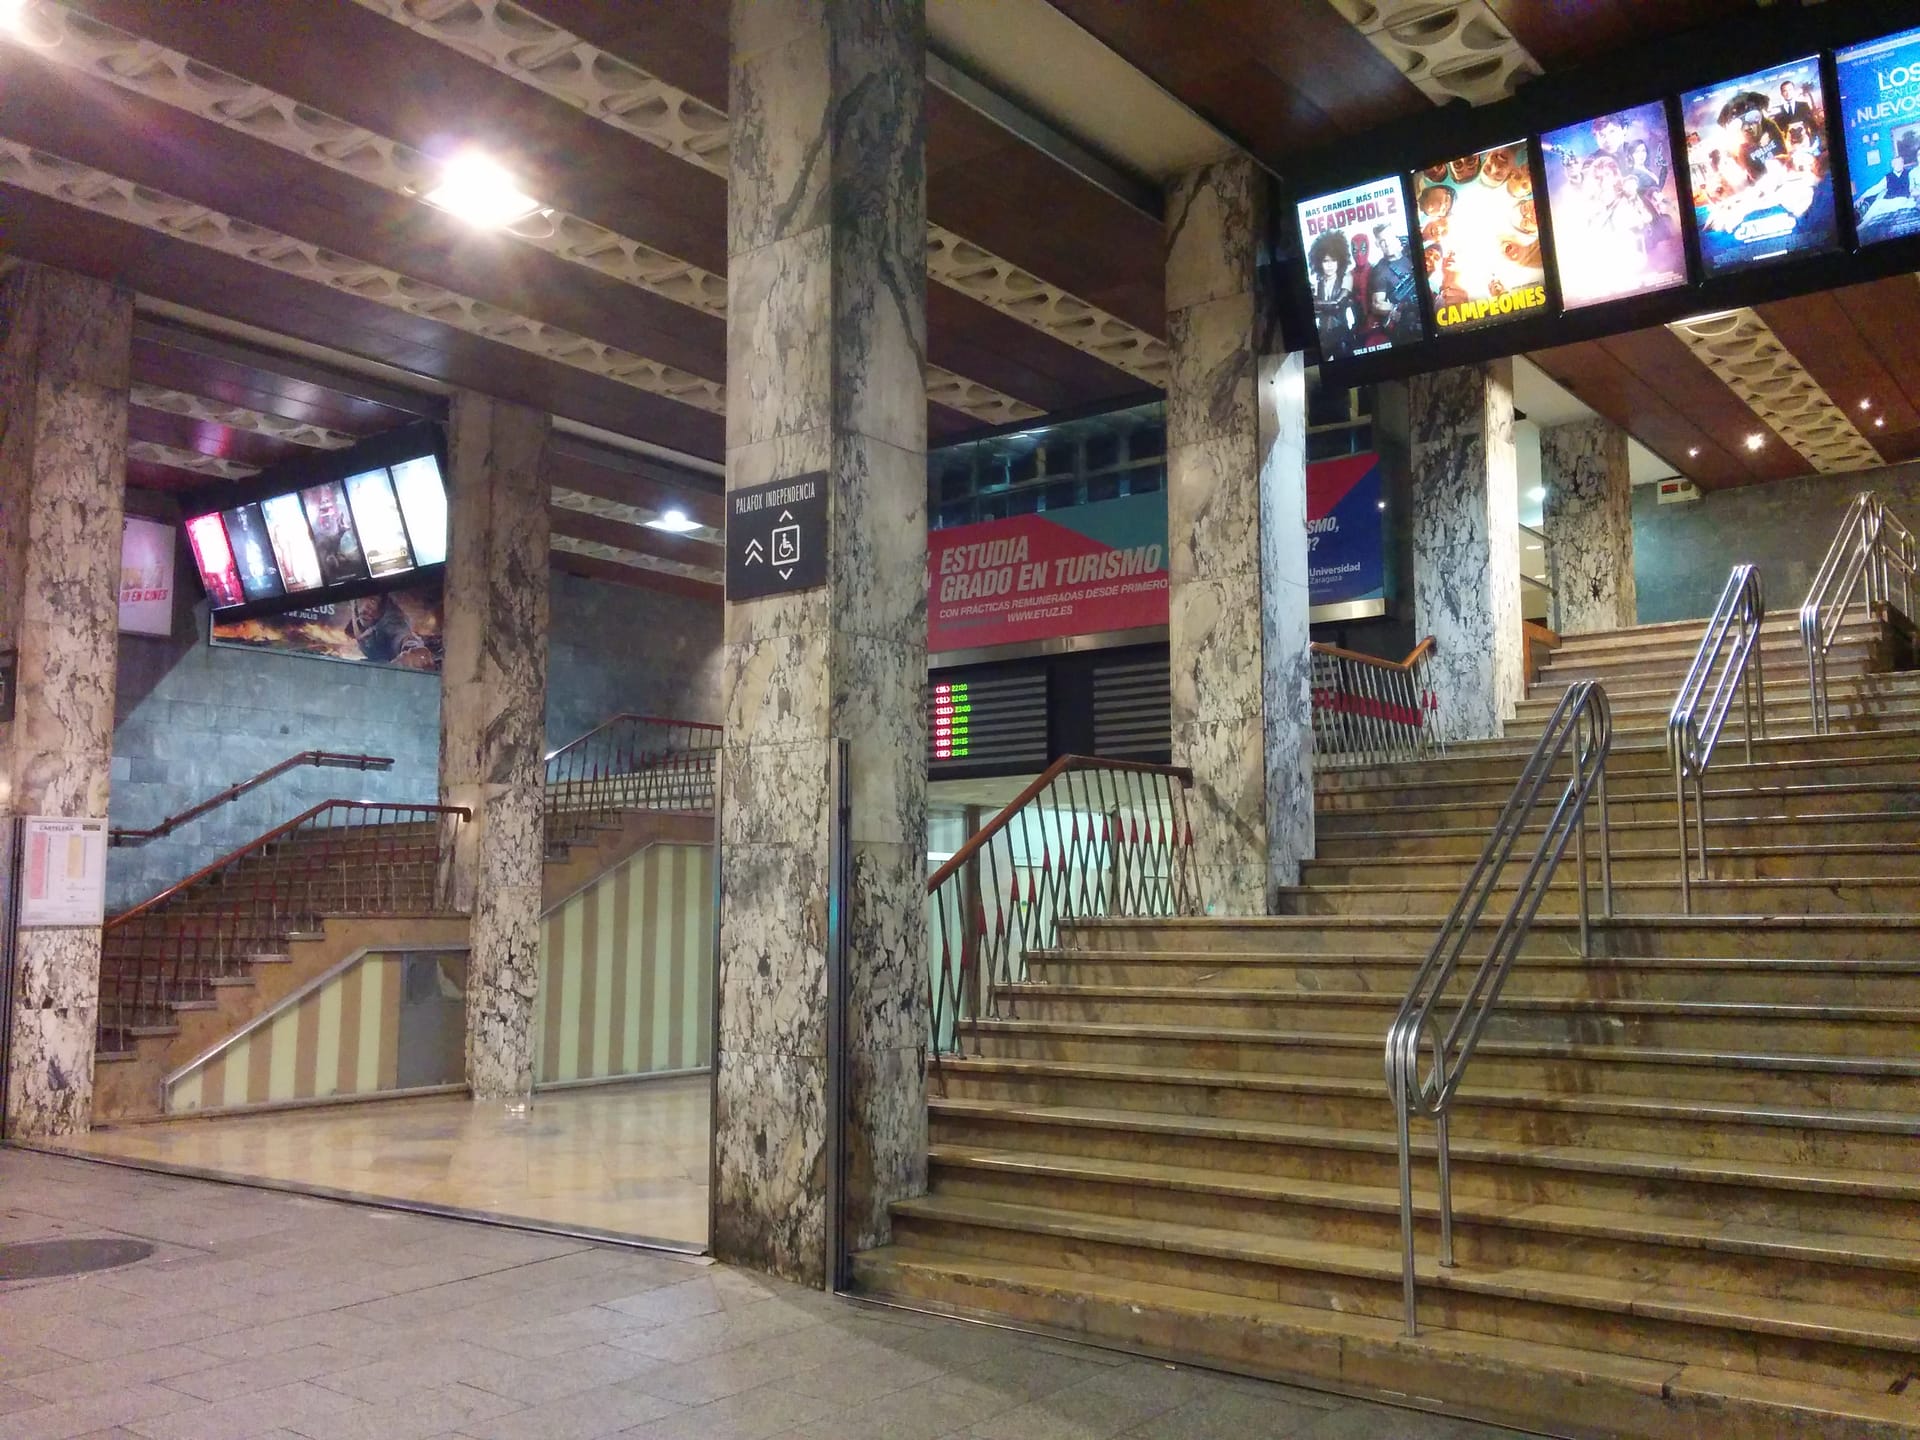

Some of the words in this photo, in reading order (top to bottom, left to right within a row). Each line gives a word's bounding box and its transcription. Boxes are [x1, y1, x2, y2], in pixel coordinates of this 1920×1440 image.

[1306, 201, 1385, 236] DEADPOOL
[1386, 197, 1397, 214] 2
[1436, 285, 1547, 327] CAMPEONES
[736, 494, 763, 514] PALAFOX
[765, 481, 816, 508] INDEPENDENCIA
[940, 535, 1029, 575] ESTUDIA
[940, 566, 1013, 603] GRADO
[1017, 560, 1049, 592] EN
[1055, 543, 1163, 587] TURISMO
[1309, 562, 1361, 577] Universidad
[940, 608, 960, 619] CON
[1012, 591, 1085, 609] REMUNERADAS
[1085, 585, 1120, 599] DESDE
[1121, 578, 1168, 594] PRIMERO
[1309, 575, 1343, 585] Zaragoza
[1007, 605, 1073, 622] WWW.ETUZ.ES
